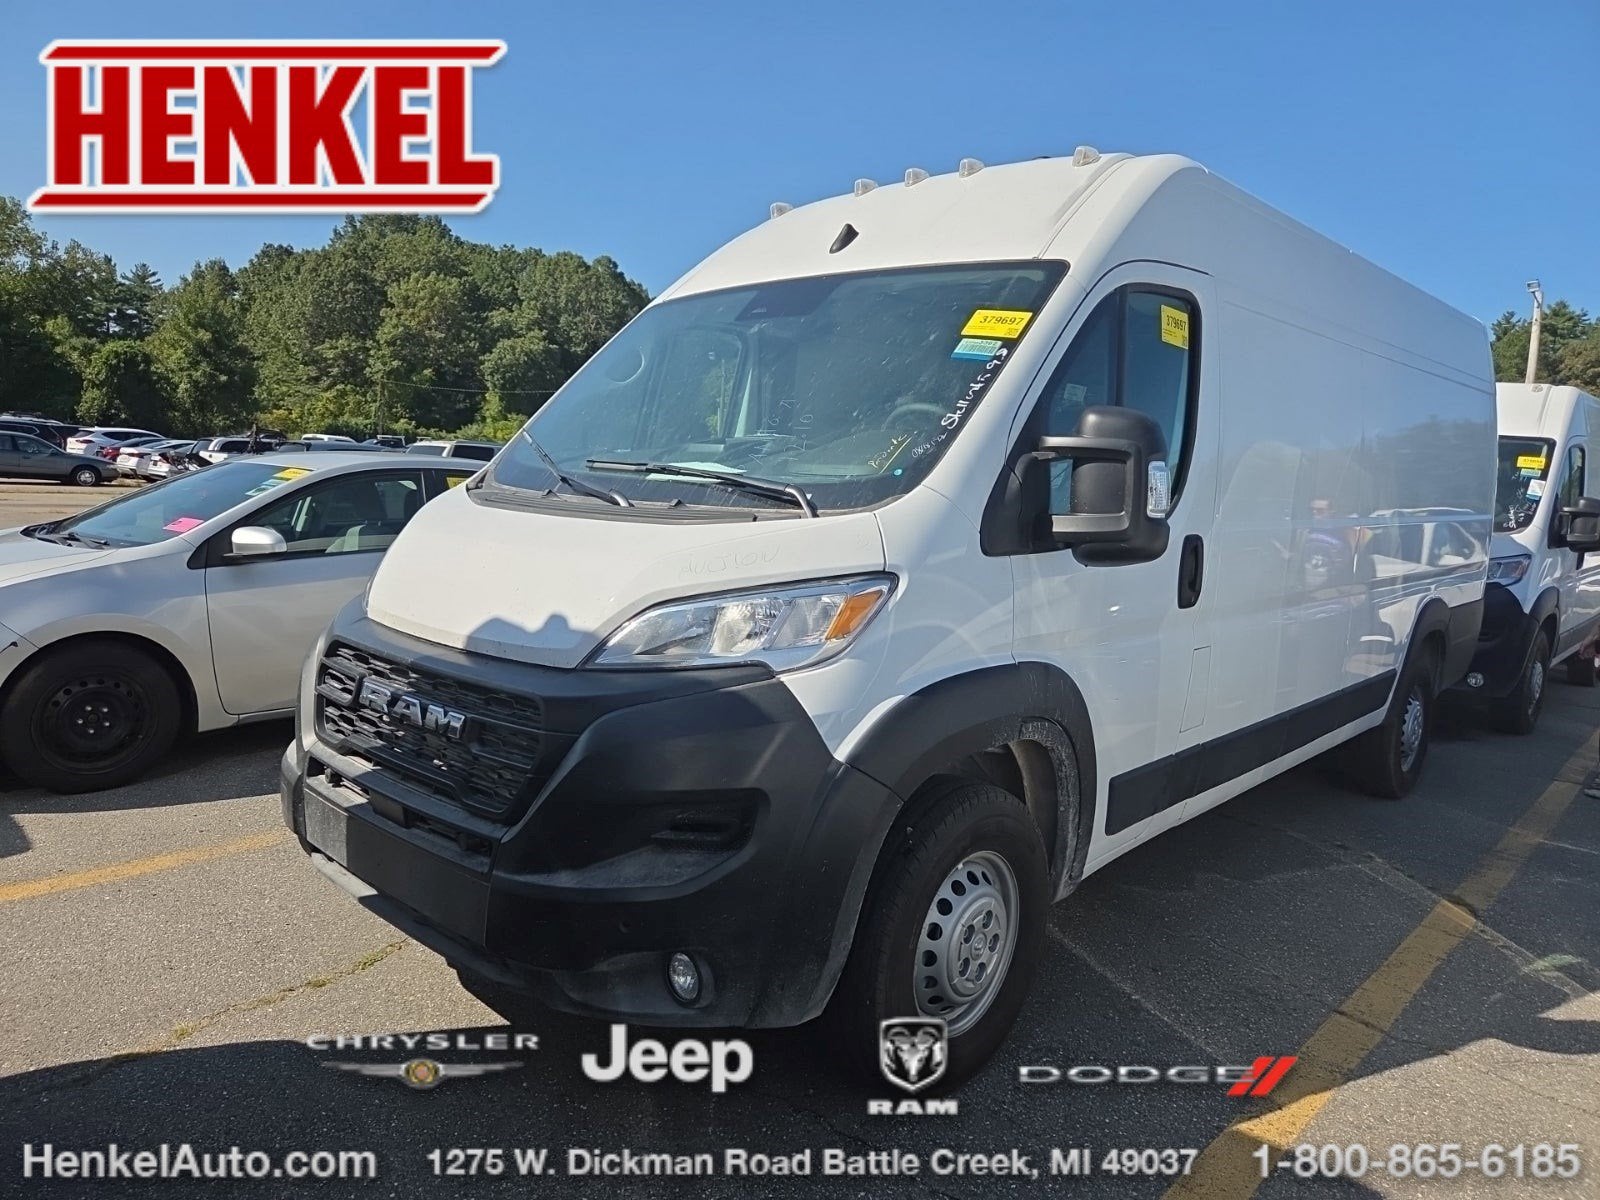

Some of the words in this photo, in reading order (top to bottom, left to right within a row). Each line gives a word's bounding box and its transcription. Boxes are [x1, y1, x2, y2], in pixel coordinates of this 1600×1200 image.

[978, 315, 1025, 326] 379697
[1166, 314, 1187, 331] 379697
[359, 681, 466, 739] RAM
